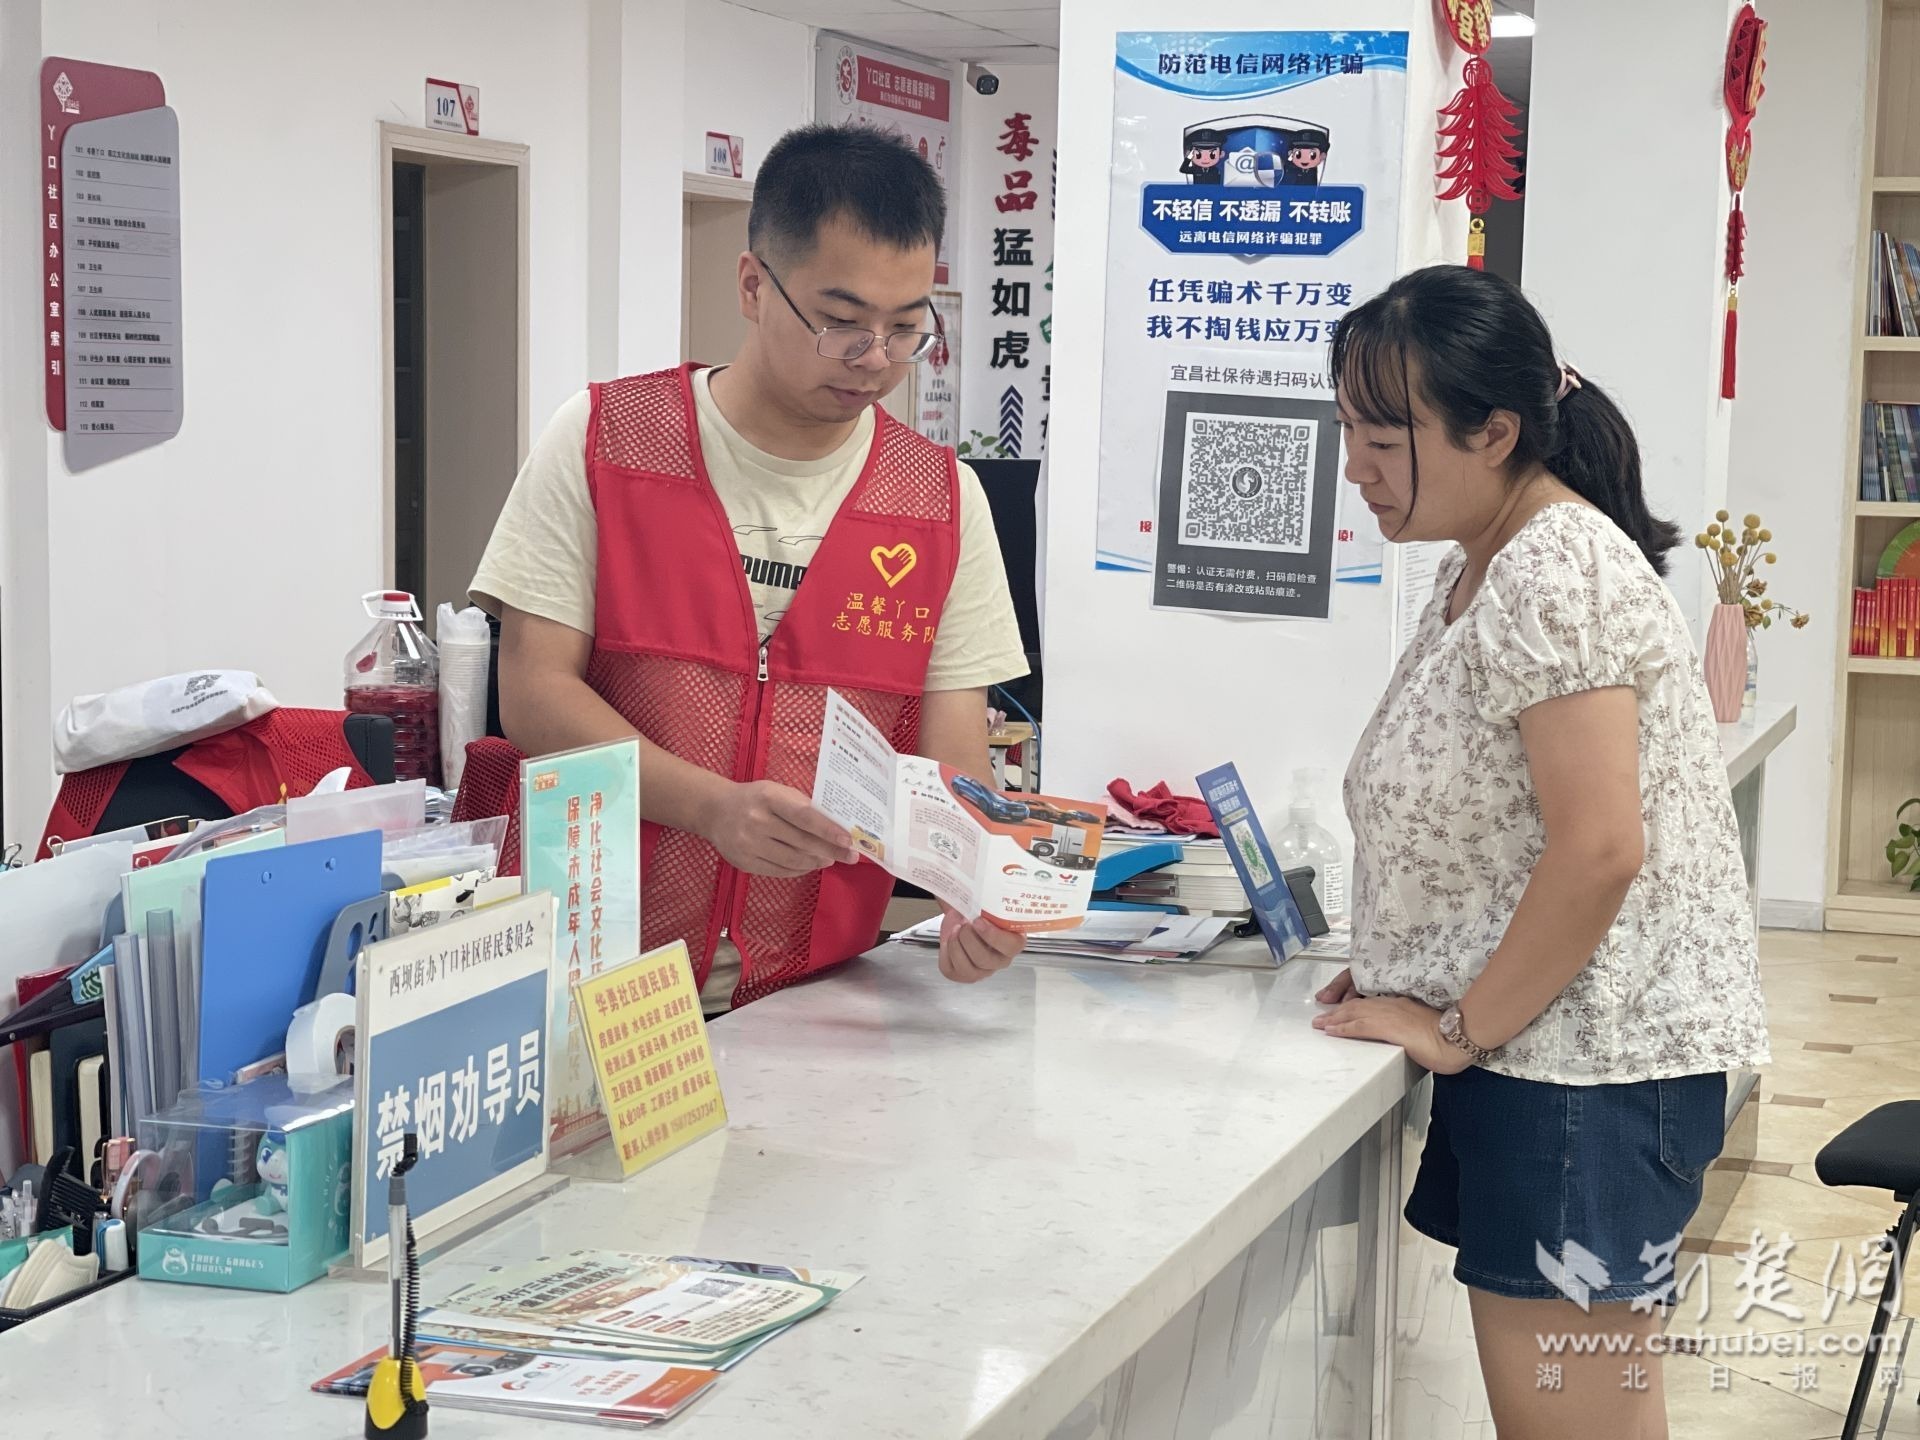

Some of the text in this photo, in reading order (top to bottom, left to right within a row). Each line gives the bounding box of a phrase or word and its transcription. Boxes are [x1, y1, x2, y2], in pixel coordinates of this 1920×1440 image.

[1158, 52, 1364, 75] 防范电信网络诈骗
[437, 97, 456, 118] 107
[714, 146, 727, 165] 108
[1152, 198, 1352, 224] 不轻信 不透漏 不转账
[48, 124, 61, 376] 丫口社区办公室索引
[1179, 230, 1323, 245] 远离电信网络诈骗犯罪
[1149, 278, 1352, 307] 任凭骗术千万变
[846, 592, 929, 620] 温馨丫口
[832, 612, 935, 644] 志愿服务队
[389, 920, 535, 998] 西坝街办丫口社区居民委员会
[376, 1029, 541, 1182] 禁烟劝导员
